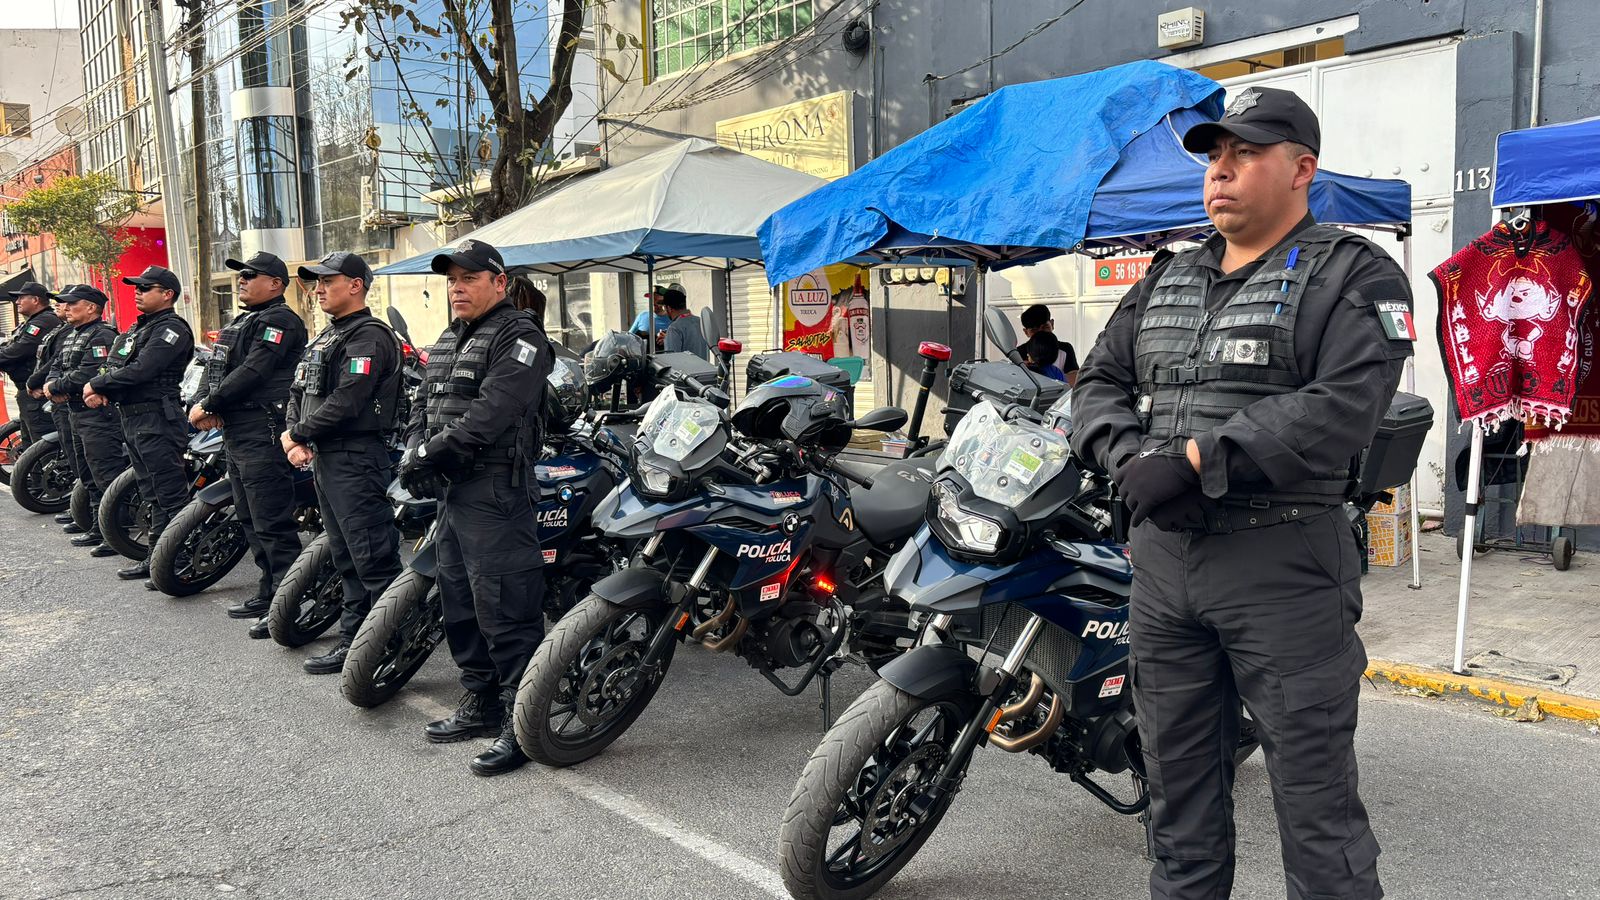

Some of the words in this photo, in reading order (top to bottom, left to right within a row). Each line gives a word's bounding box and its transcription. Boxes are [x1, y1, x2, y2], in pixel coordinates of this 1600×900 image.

[734, 111, 825, 152] VERONA
[1455, 167, 1491, 192] 113
[1115, 263, 1125, 280] 56
[1127, 262, 1136, 279] 19
[1137, 261, 1147, 278] 31
[794, 292, 804, 303] LA
[807, 291, 825, 303] LUZ
[536, 506, 568, 523] LICÍA
[542, 520, 568, 528] TOLUCA
[736, 538, 792, 559] POLICÍA
[765, 554, 791, 563] TOLUCA
